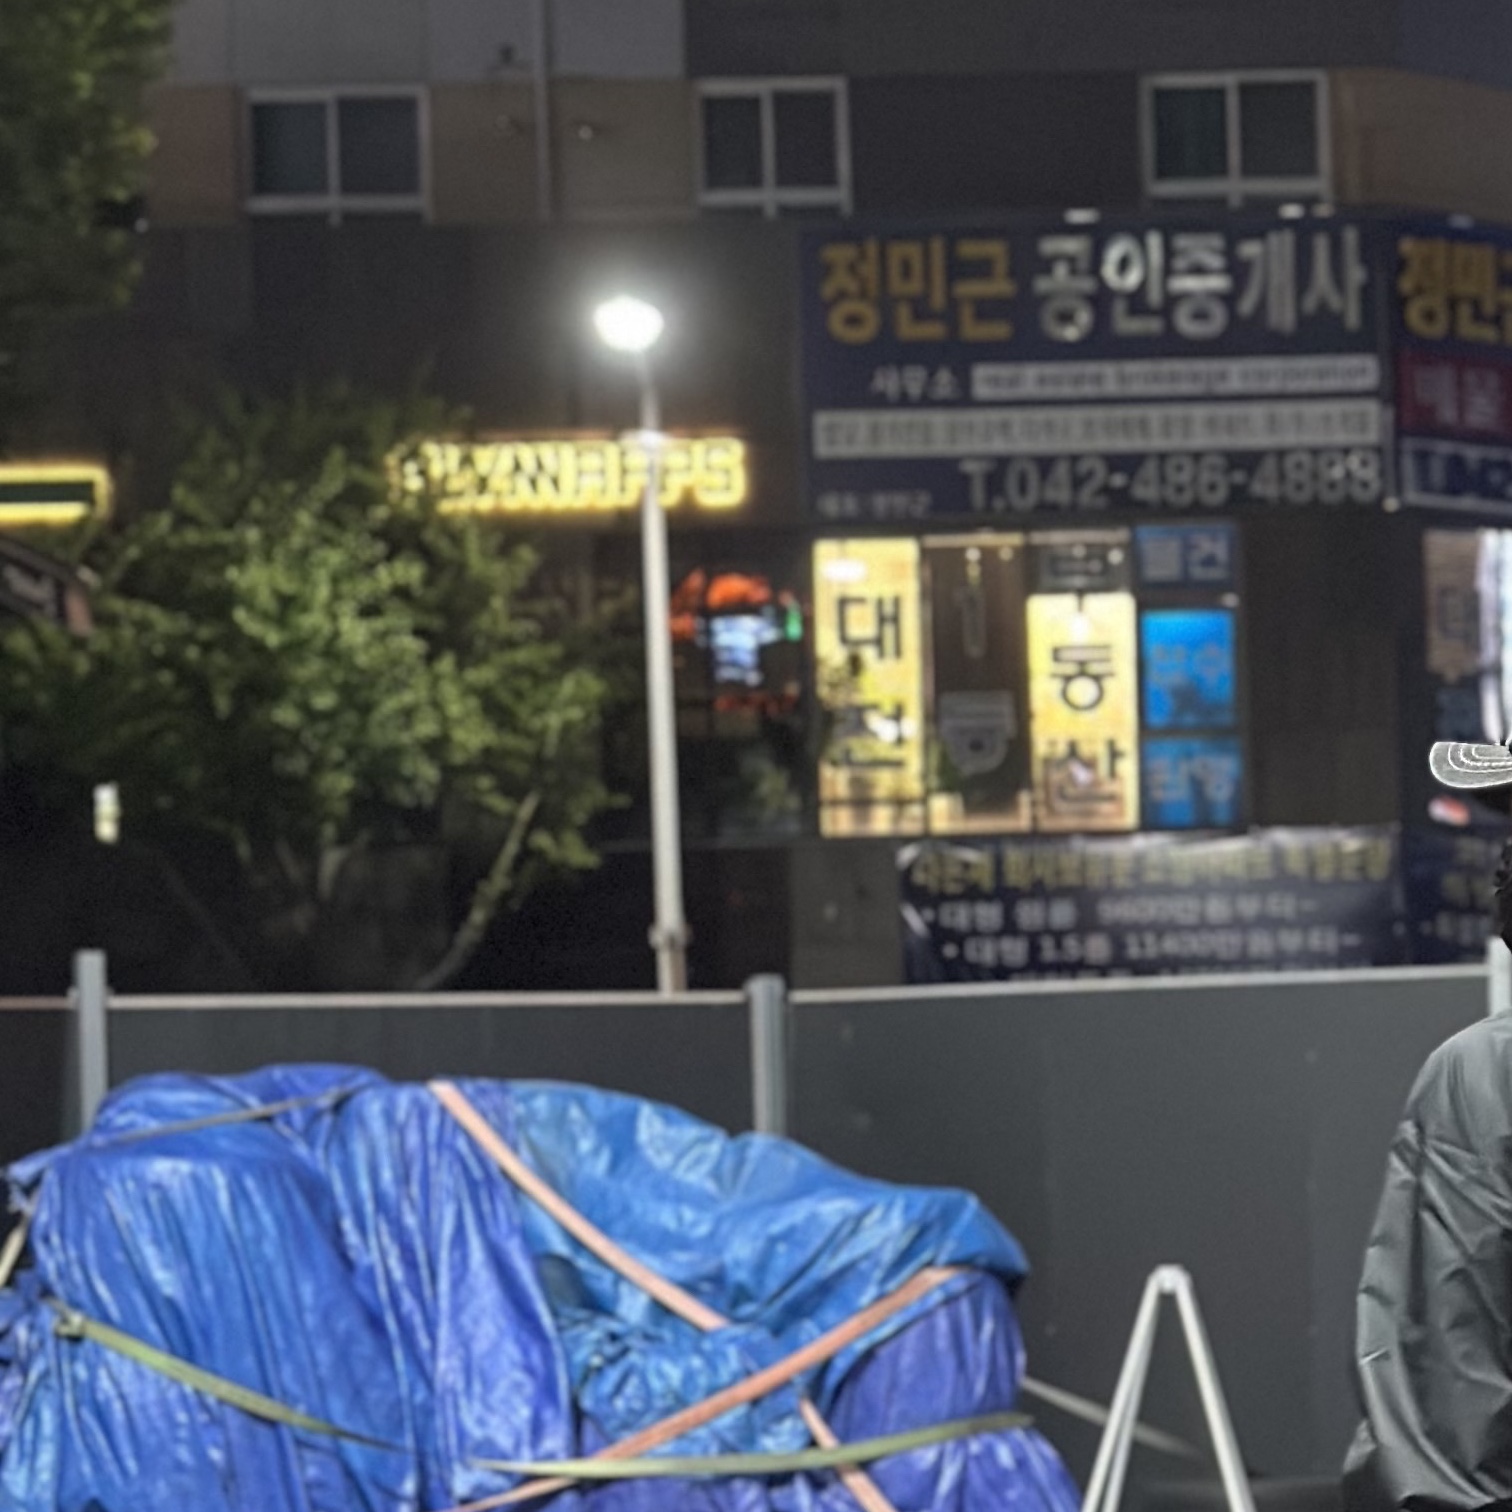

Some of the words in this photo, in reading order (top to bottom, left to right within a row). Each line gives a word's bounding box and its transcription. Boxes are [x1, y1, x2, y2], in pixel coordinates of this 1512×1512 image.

[819, 240, 1017, 344] 정민근
[1031, 228, 1368, 340] 공인중개사
[869, 363, 963, 404] 사무소
